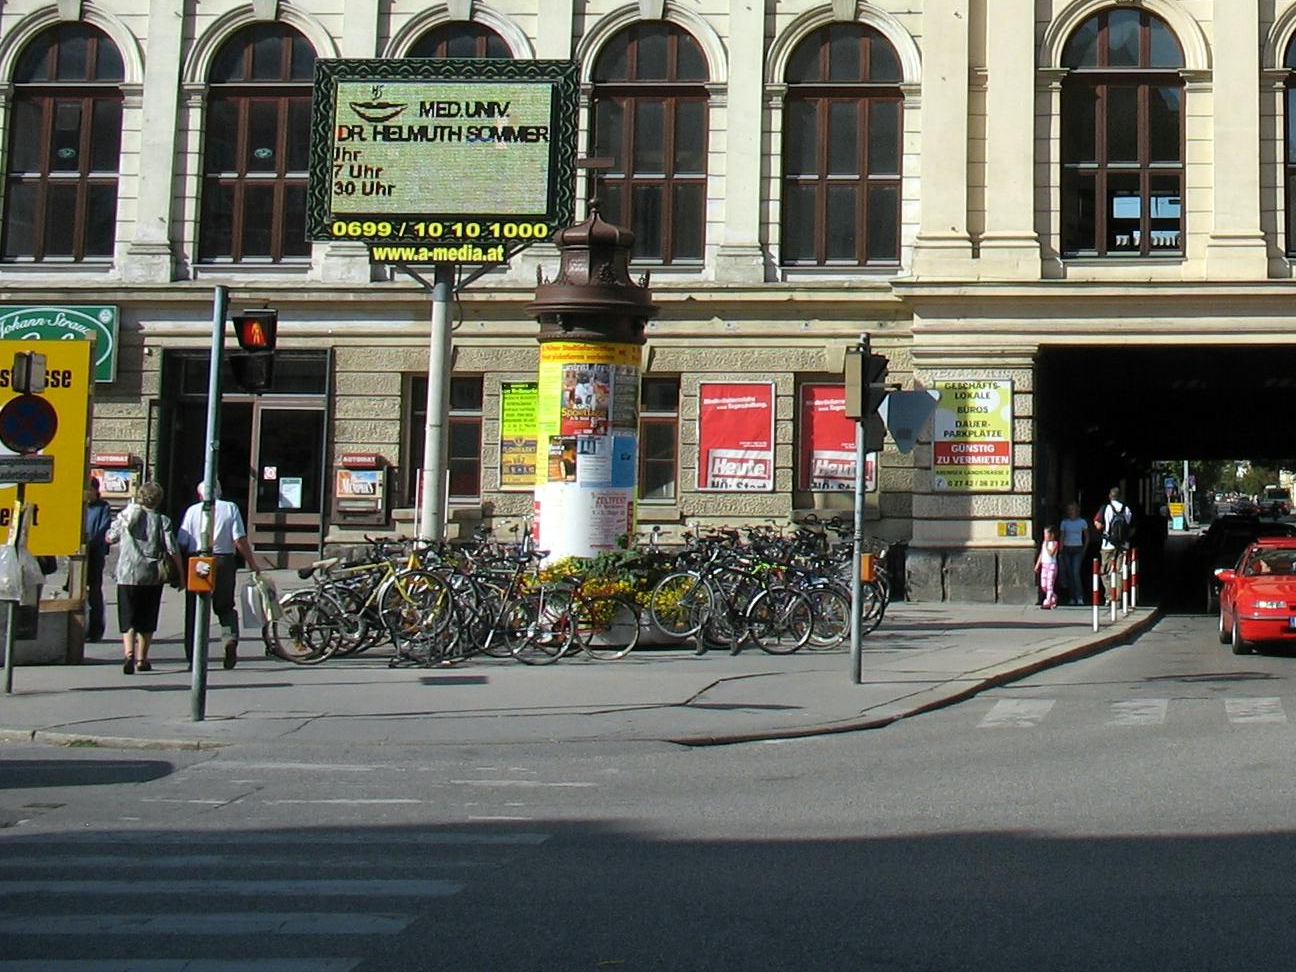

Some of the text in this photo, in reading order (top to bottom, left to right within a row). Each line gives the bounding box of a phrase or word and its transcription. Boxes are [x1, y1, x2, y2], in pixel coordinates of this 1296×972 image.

[373, 125, 462, 143] HELMUTH
[466, 125, 550, 143] SOMMER
[350, 164, 384, 179] Uhr
[362, 180, 397, 196] Uhr
[332, 221, 393, 237] 0699
[415, 222, 443, 237] 10
[452, 222, 481, 237] 10
[489, 222, 548, 238] 1000
[373, 244, 504, 262] www.a-media.at
[944, 381, 1001, 390] GESCHÄFTS-
[954, 391, 991, 400] LOKALE
[957, 405, 989, 414] BÜROS
[955, 420, 991, 428] DAUER-
[943, 429, 1003, 438] PARKPLÄTZE
[951, 443, 996, 453] GÜNSTIG
[936, 455, 1009, 465] ZU VERMIETEN
[712, 458, 766, 475] Heute
